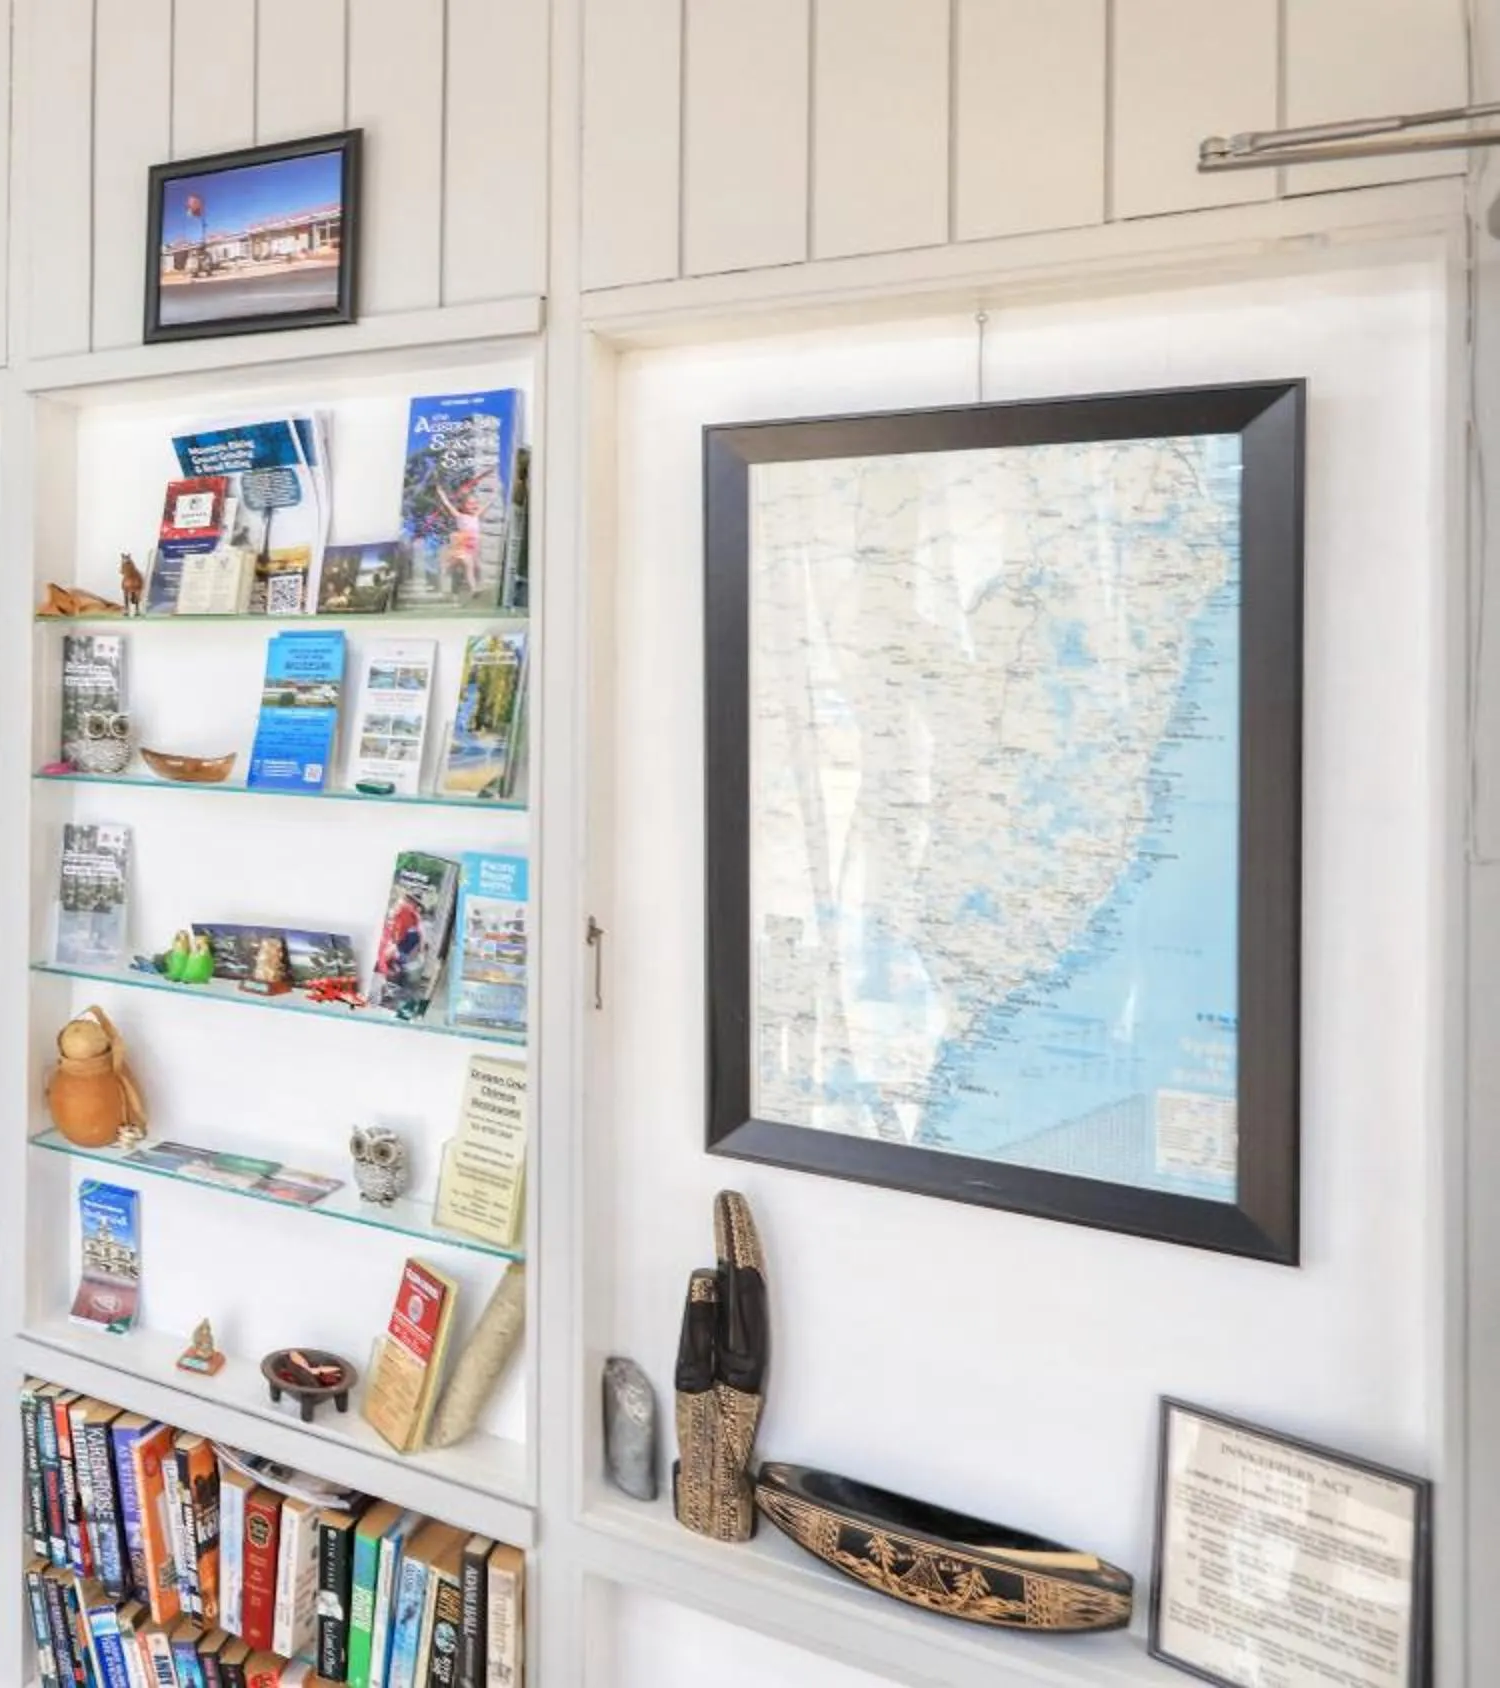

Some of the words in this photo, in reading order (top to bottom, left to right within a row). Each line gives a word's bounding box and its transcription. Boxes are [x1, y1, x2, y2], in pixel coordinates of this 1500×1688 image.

[87, 1426, 110, 1479] KAREN
[92, 1479, 116, 1521] ROSE
[154, 1655, 175, 1687] ANDY
